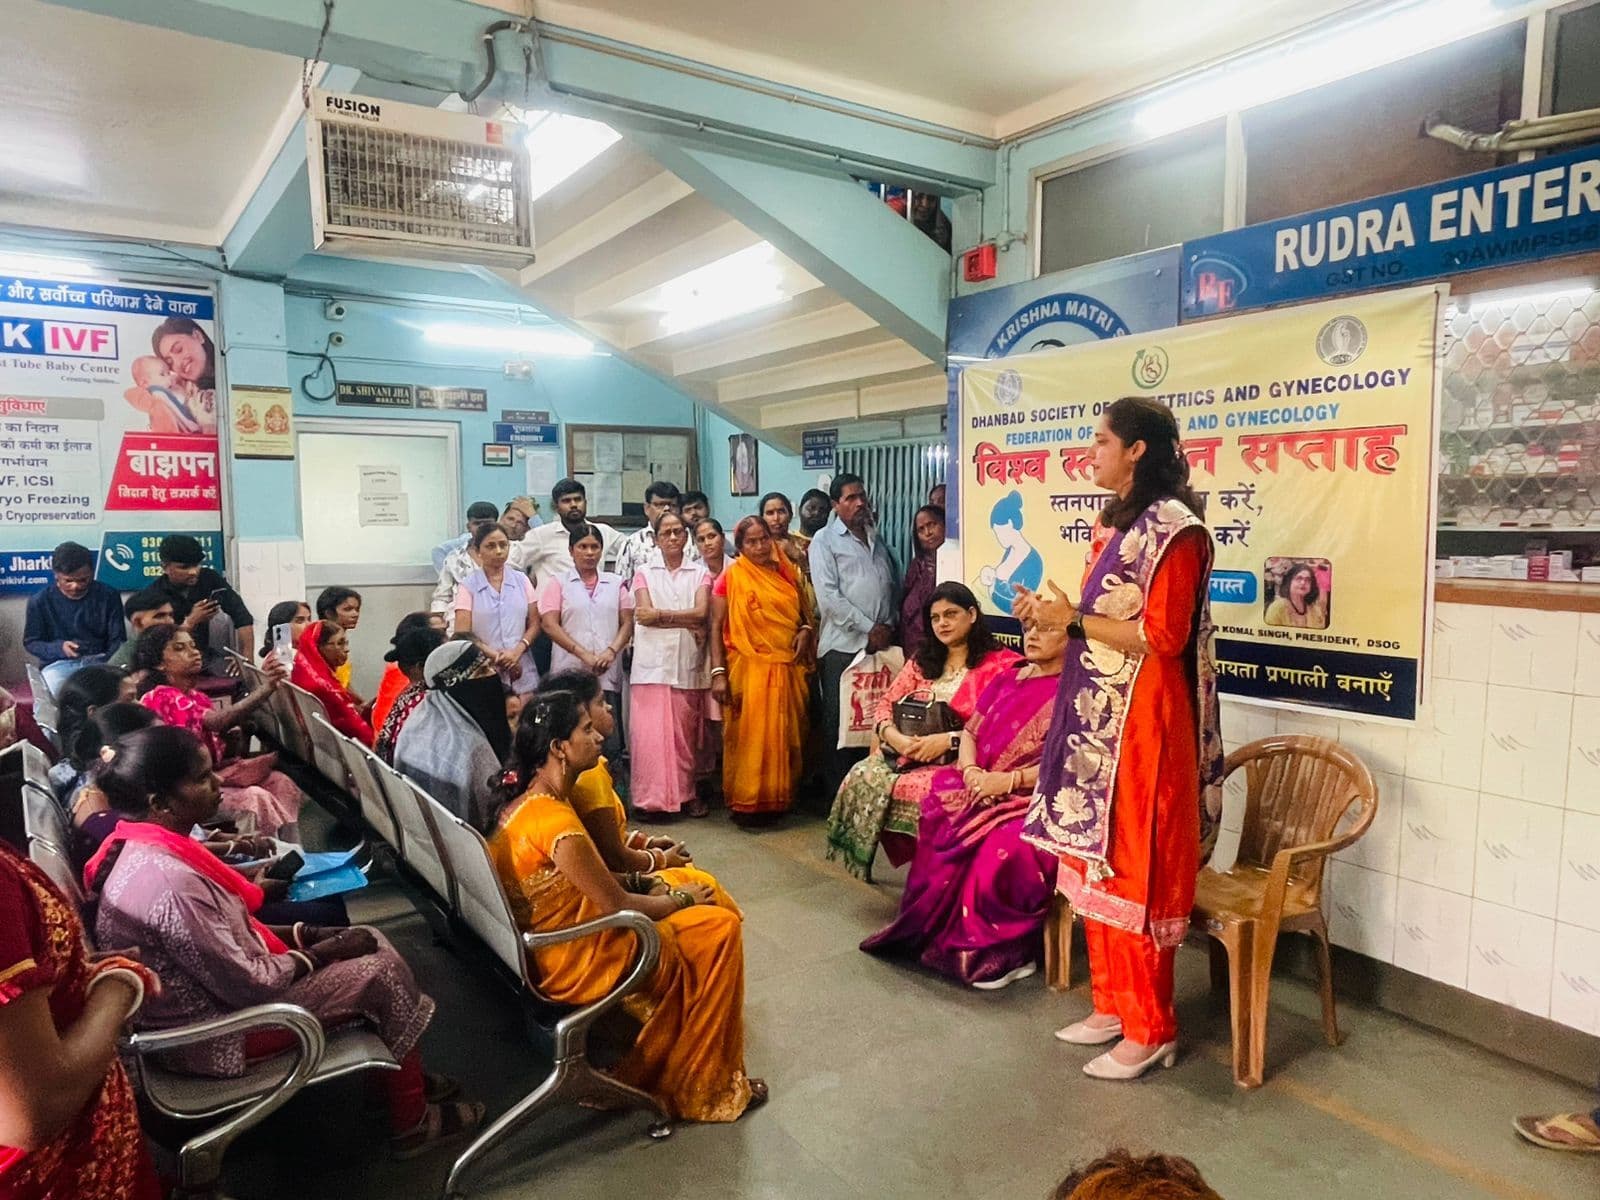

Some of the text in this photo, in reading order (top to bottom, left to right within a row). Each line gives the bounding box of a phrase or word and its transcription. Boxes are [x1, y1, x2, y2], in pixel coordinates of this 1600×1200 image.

[326, 96, 380, 116] FUSION
[1275, 158, 1600, 273] RUDRA ENTER
[8, 280, 198, 314] और सर्वोच्च परिणाम देने वाला
[997, 300, 1114, 350] KRISHNA MATRI
[51, 326, 110, 352] IVF
[13, 359, 42, 370] Tube
[46, 361, 76, 377] Baby
[80, 362, 120, 375] Centre
[971, 412, 1026, 429] DHANBAD
[1030, 405, 1086, 422] SOCIETY
[1223, 385, 1260, 403] AND
[1269, 368, 1411, 399] GYNECOLOGY
[5, 421, 59, 433] का निदान
[1006, 428, 1073, 446] FEDERATION
[1078, 426, 1094, 440] OF
[1188, 414, 1218, 431] AND
[1225, 404, 1341, 428] GYNECOLOGY
[126, 443, 216, 479] बांझपन
[973, 441, 1051, 487] विश्व
[1238, 424, 1408, 475] सप्ताह
[24, 475, 54, 487] ICSI
[28, 493, 91, 507] Freezing
[6, 510, 96, 523] Cryopreservation
[1214, 519, 1251, 547] करें
[1222, 626, 1254, 637] KOMAL
[1258, 629, 1293, 641] SINGH,
[1296, 633, 1360, 648] PRESIDENT,
[1367, 639, 1401, 651] DSOG
[1265, 665, 1329, 690] प्रणाली
